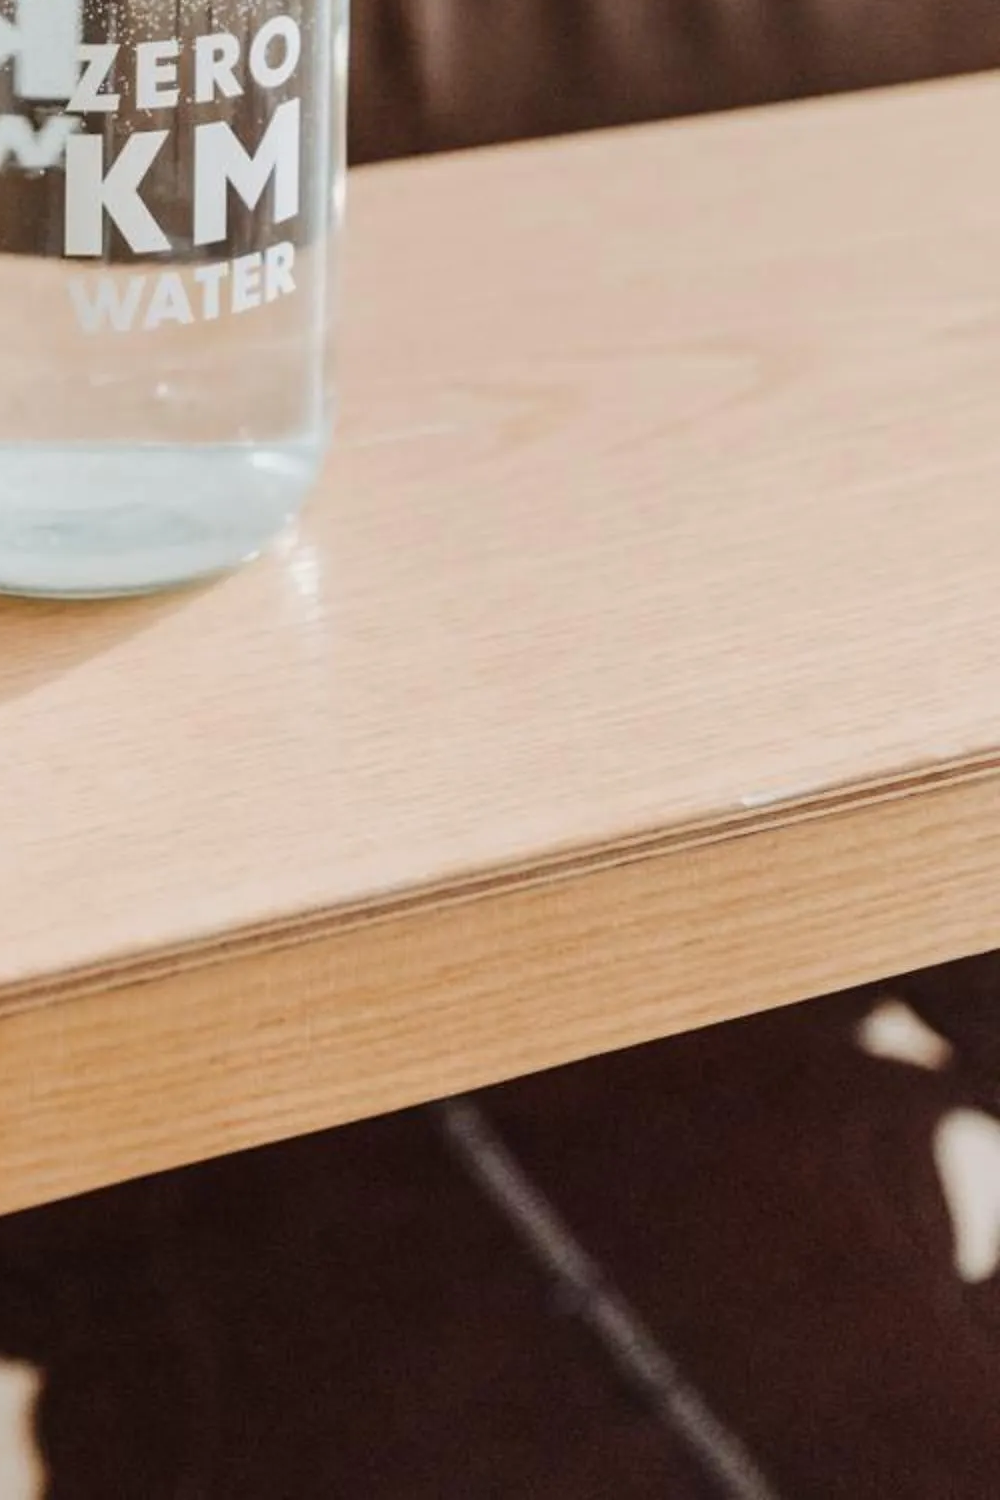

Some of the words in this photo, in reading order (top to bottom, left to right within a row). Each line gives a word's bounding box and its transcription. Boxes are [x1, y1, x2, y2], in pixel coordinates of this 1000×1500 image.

[66, 15, 301, 112] ZERO
[65, 97, 301, 256] KM
[68, 241, 297, 332] WATER
